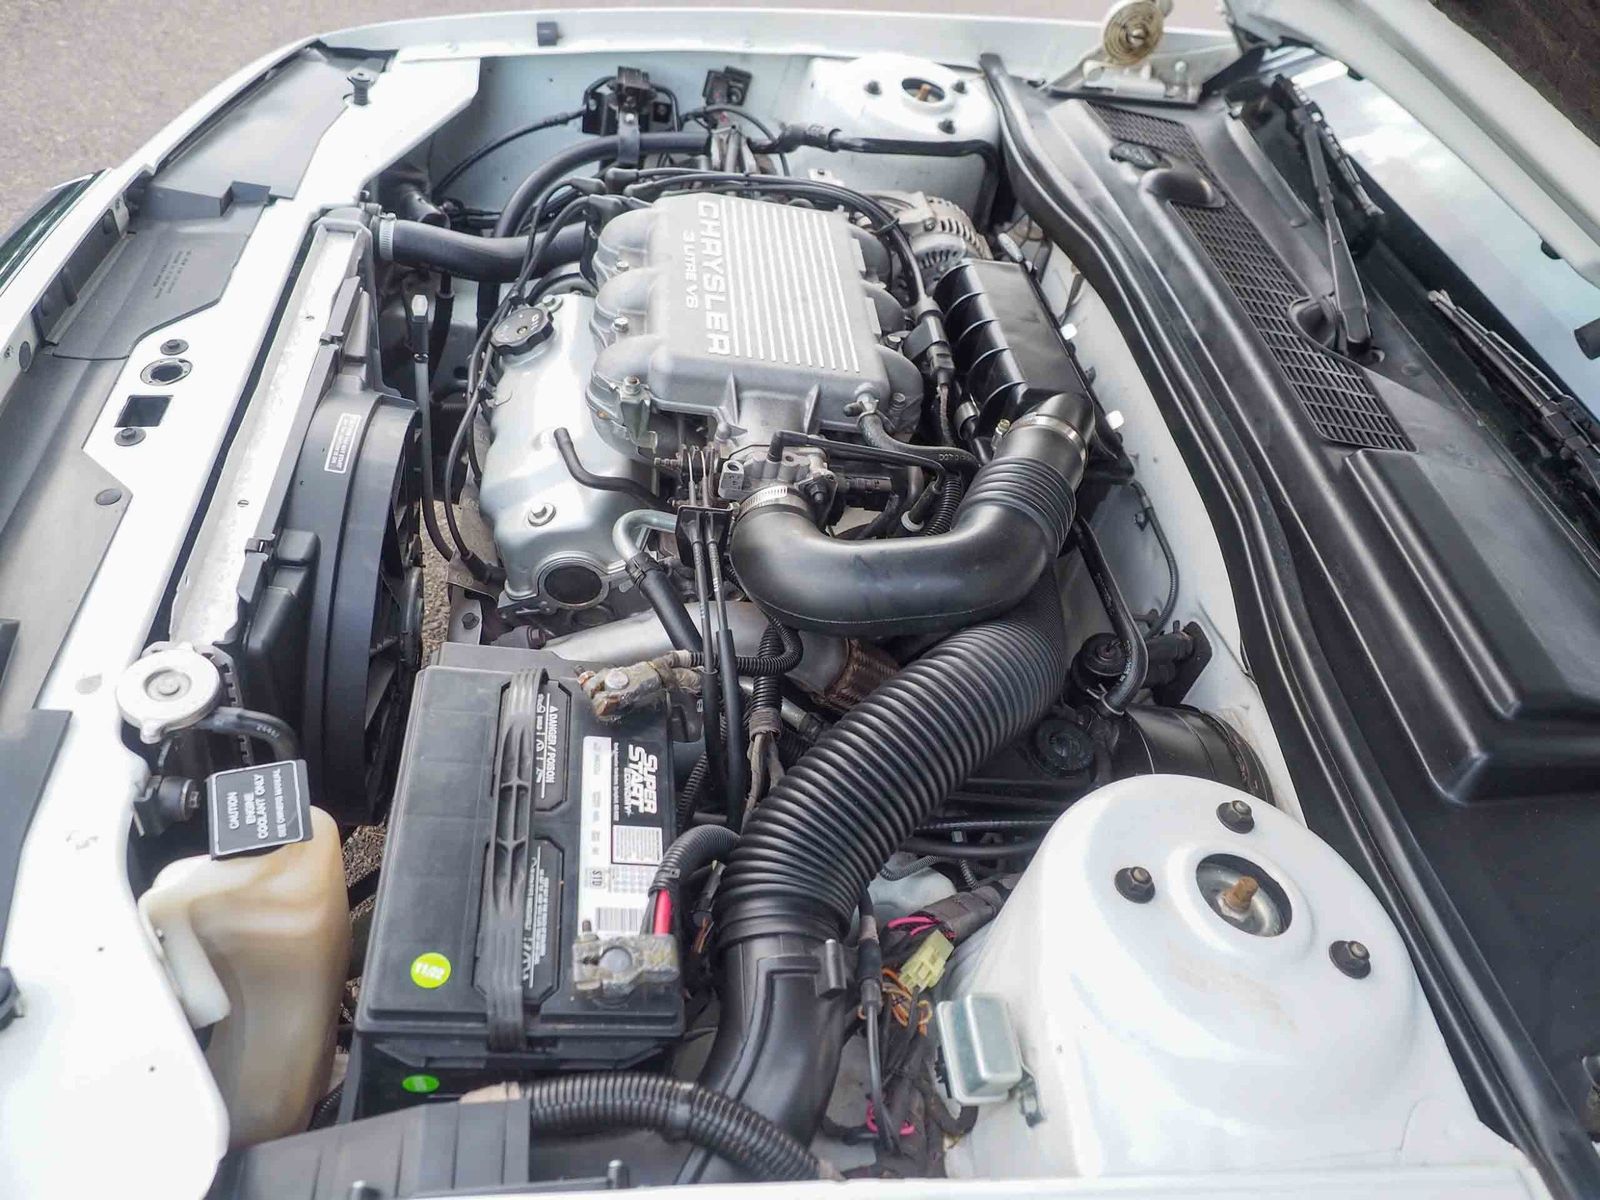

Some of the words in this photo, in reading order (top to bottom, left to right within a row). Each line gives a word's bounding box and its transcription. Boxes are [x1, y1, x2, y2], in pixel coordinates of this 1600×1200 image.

[683, 229, 696, 243] 3
[684, 242, 697, 281] LITRE
[698, 200, 731, 356] CHRYSLER
[685, 284, 699, 310] V6
[253, 774, 266, 796] ONLY
[628, 744, 646, 813] START
[643, 753, 658, 814] SUPER
[227, 791, 240, 829] CAUTION
[255, 798, 269, 839] COOLANT
